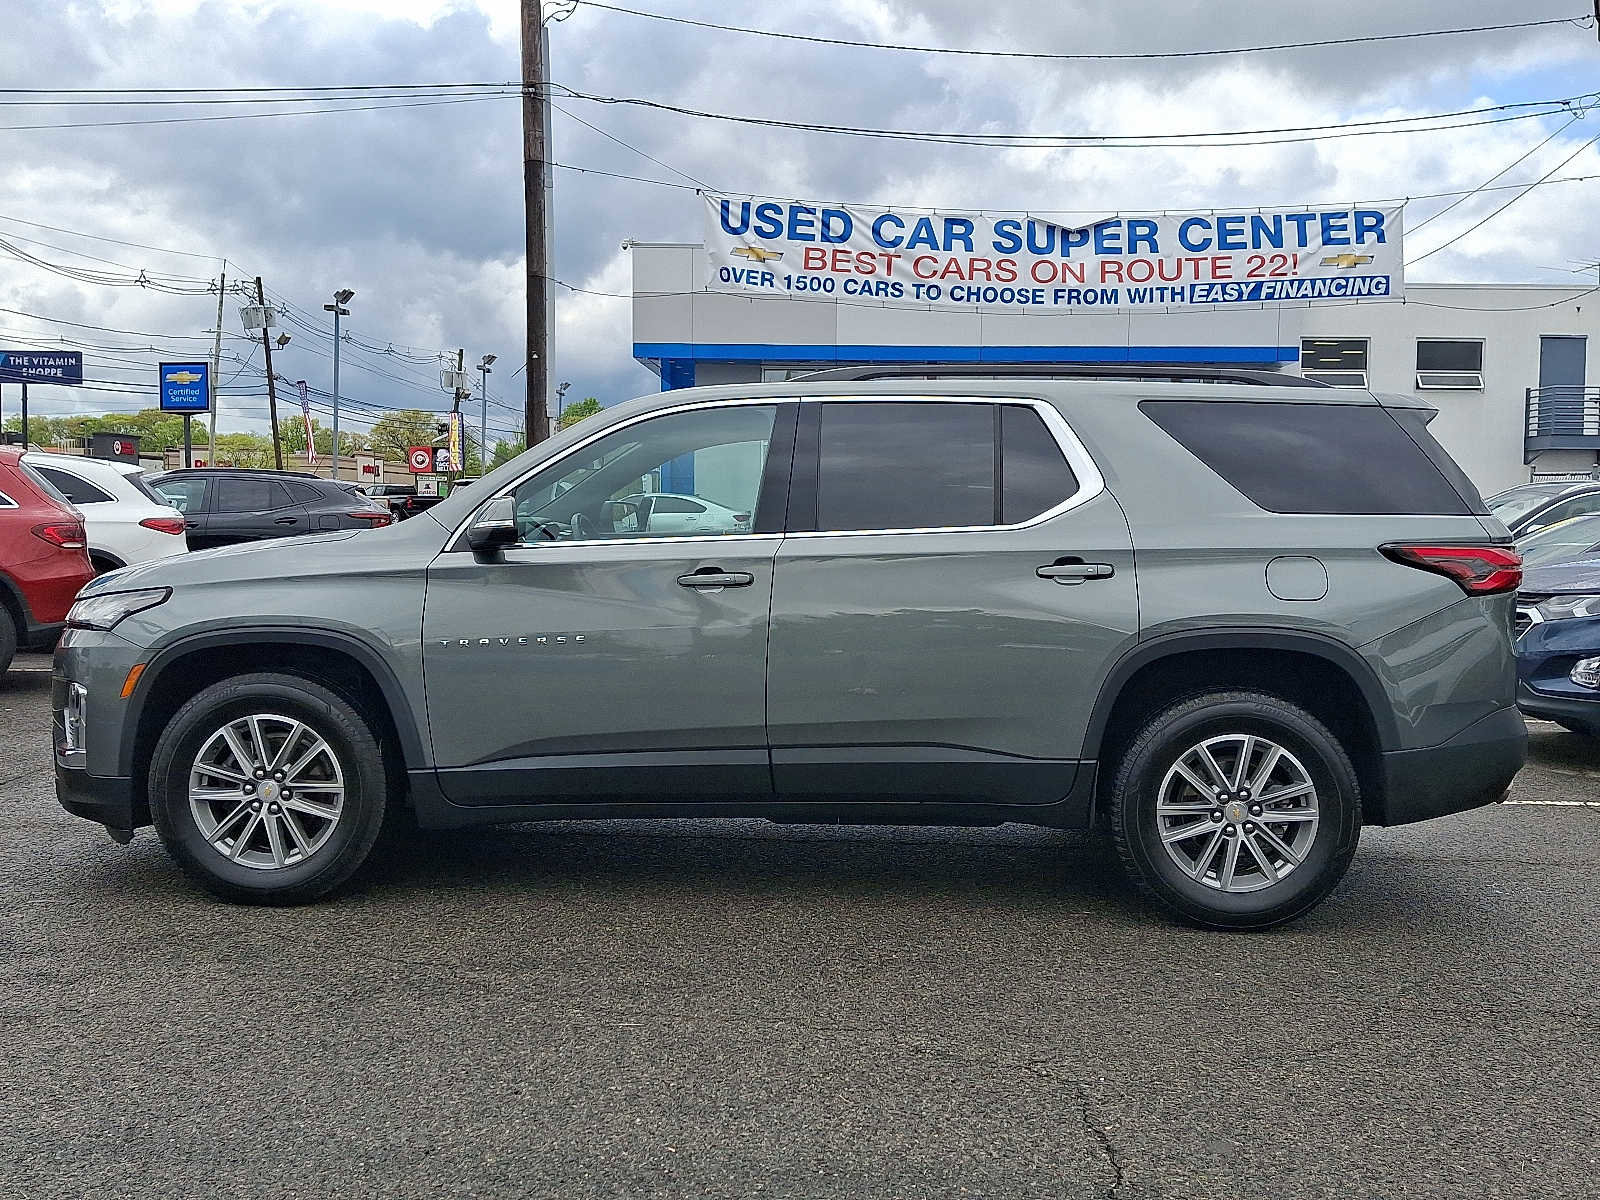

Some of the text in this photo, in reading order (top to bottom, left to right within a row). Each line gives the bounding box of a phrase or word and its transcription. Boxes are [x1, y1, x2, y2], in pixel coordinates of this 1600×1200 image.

[720, 200, 1386, 257] USED CAR SUPER CENTER
[803, 247, 1299, 284] BEST CARS ON ROUTE 22!
[719, 266, 1388, 305] OVER 1500 CARS TO CHOOSE FROM WITH EASY FINANCING
[9, 356, 76, 366] THE VITAMIN
[22, 367, 63, 376] SHOPPE
[168, 388, 200, 396] Certified
[440, 635, 585, 648] TRAVERSE
